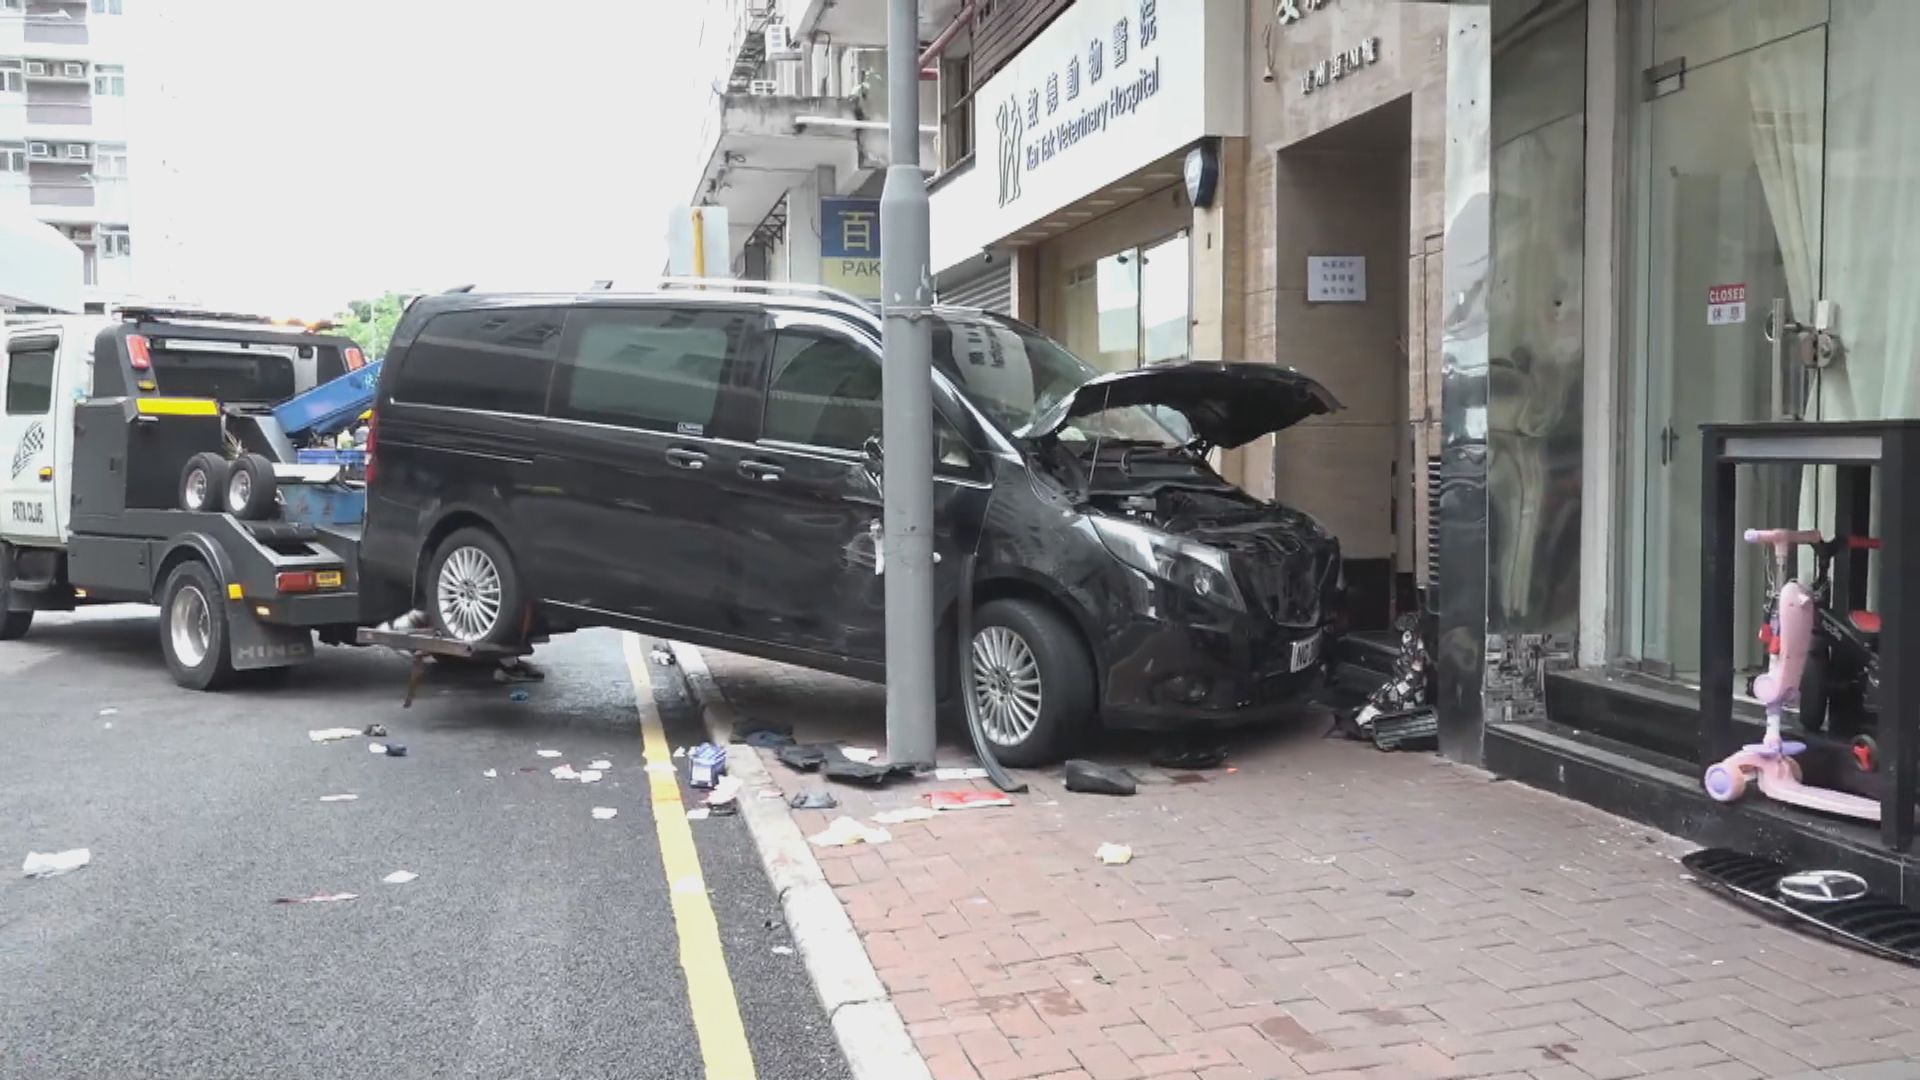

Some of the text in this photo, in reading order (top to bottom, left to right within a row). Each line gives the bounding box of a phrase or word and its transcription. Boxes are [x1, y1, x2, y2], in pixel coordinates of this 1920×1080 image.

[1026, 56, 1159, 172] Kai Tak Veterinary Hospital
[838, 211, 875, 251] 百
[1710, 288, 1744, 302] CLOSED
